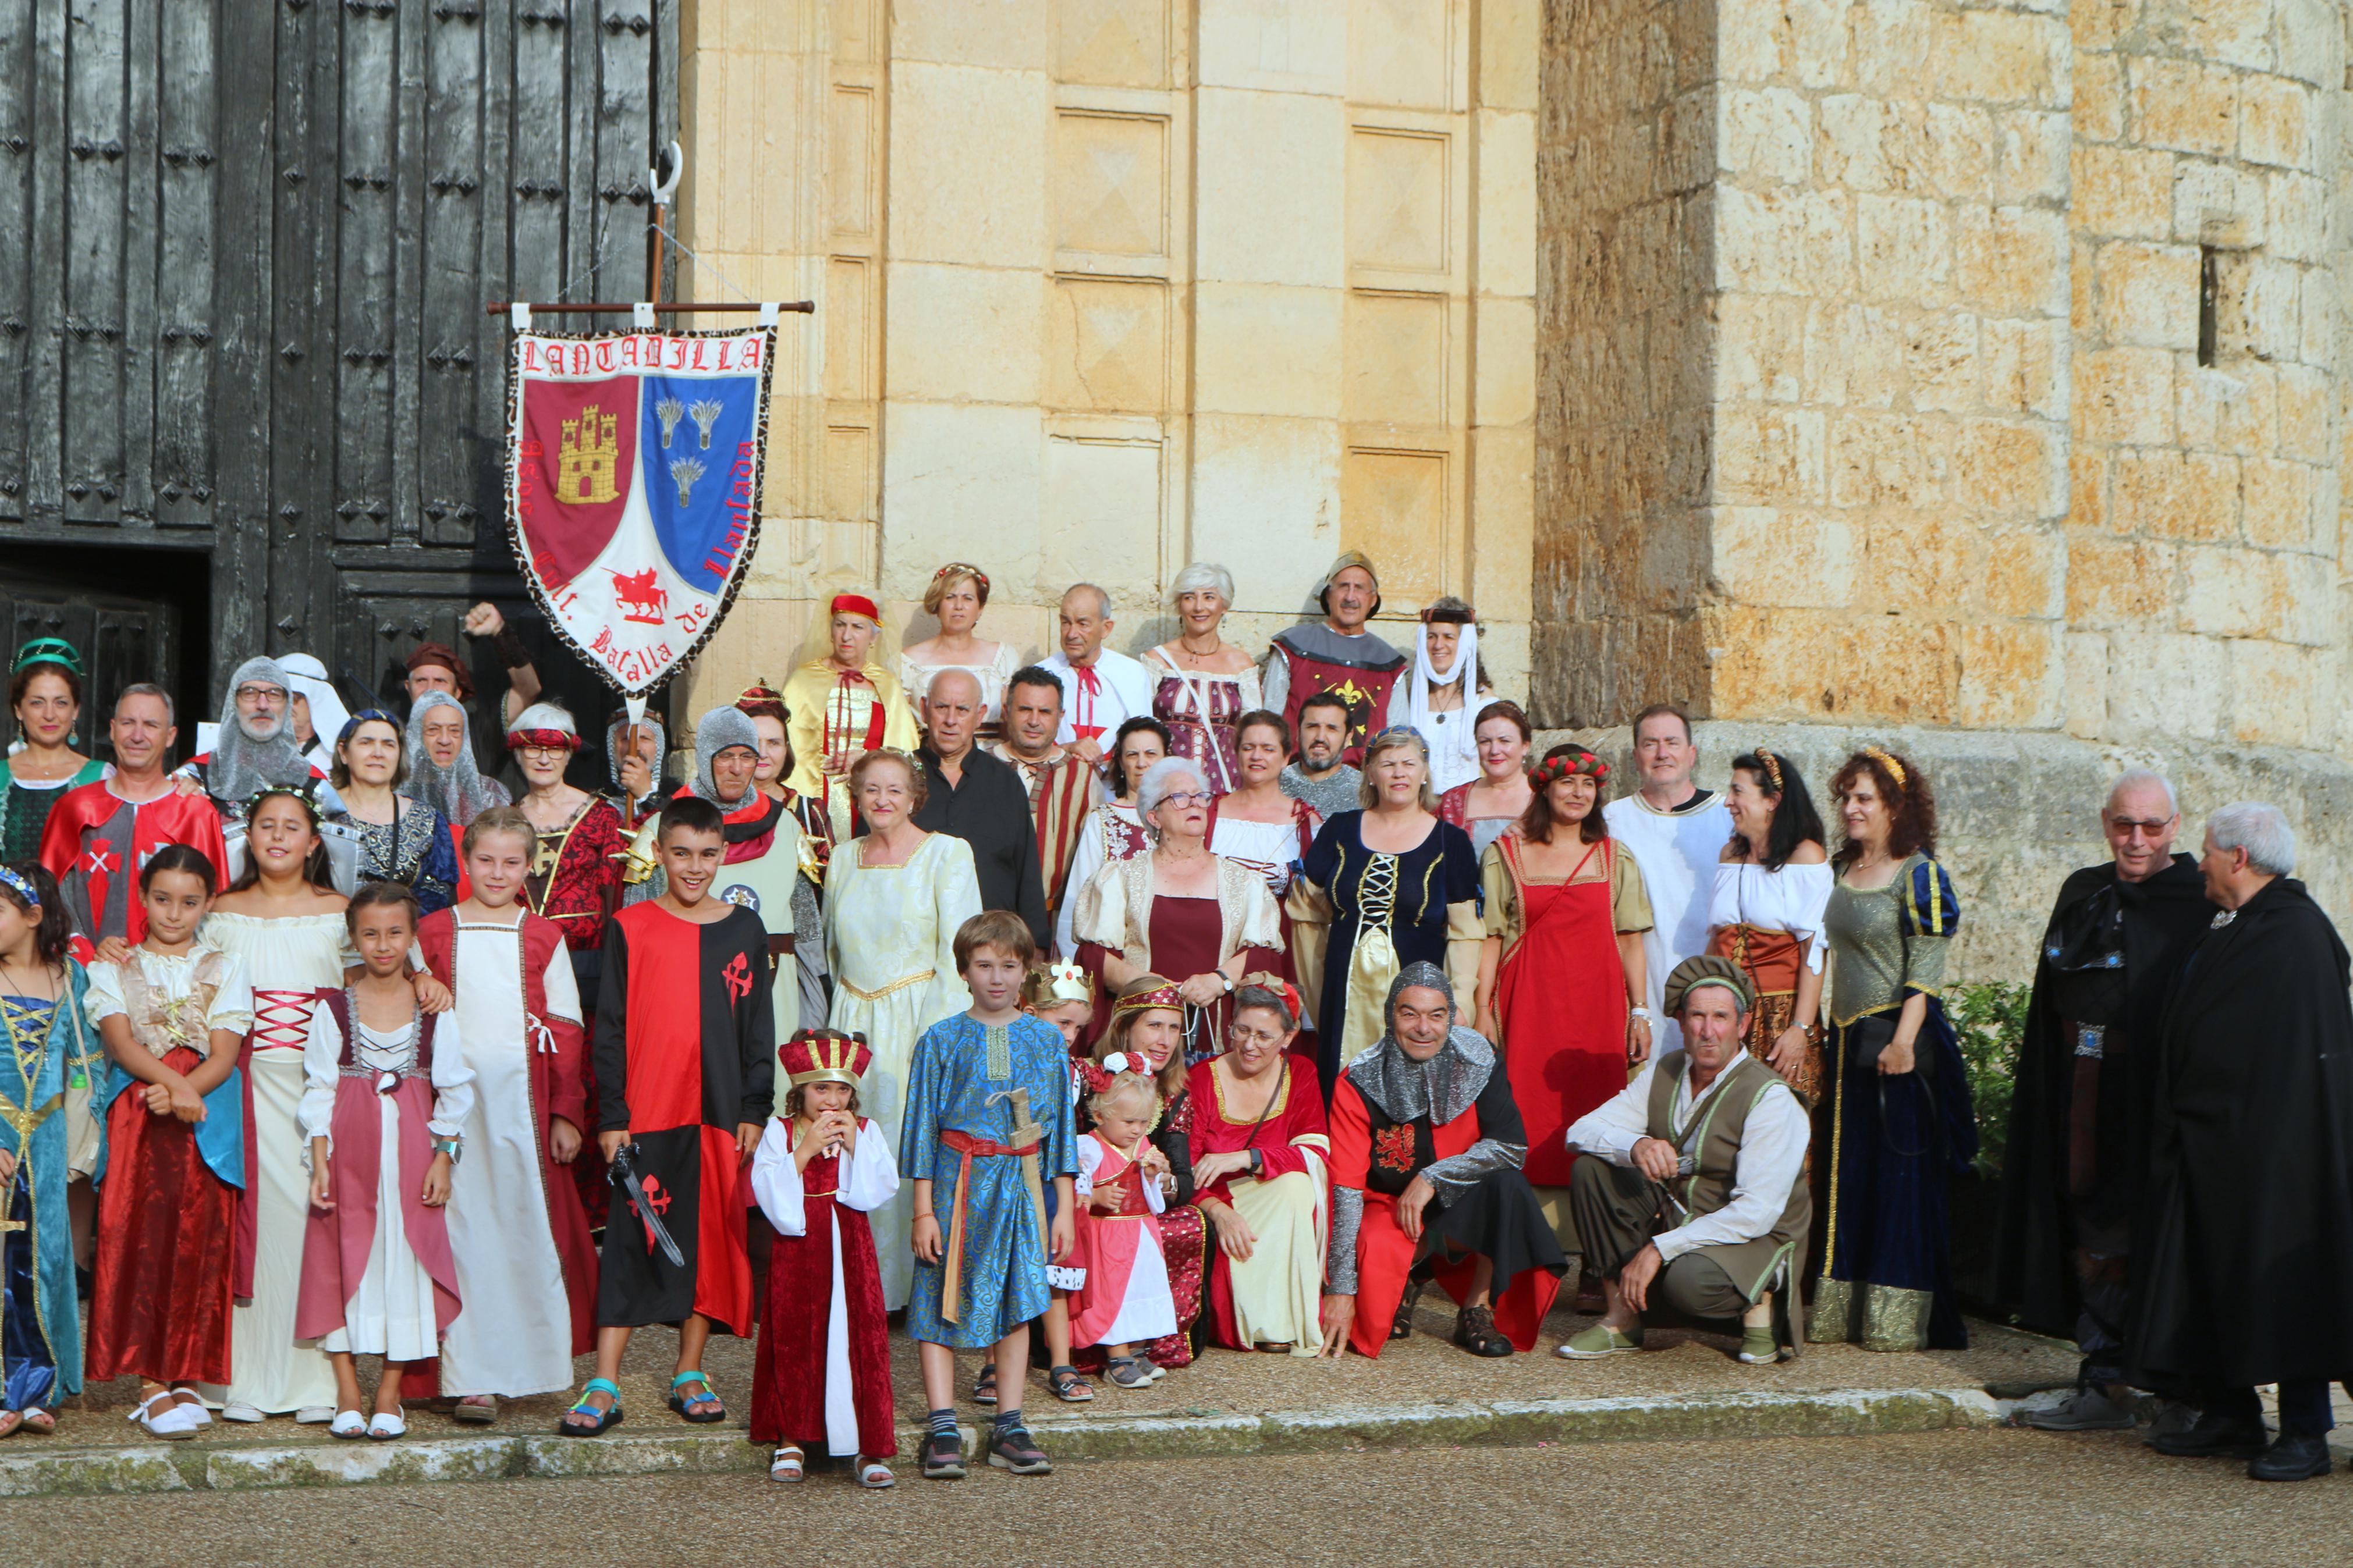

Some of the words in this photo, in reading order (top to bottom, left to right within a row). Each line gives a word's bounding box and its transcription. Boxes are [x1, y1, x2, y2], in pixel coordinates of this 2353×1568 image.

[523, 336, 762, 376] LANTADILLA
[533, 551, 577, 620] Cult.
[589, 624, 673, 681] Batalla
[675, 603, 708, 633] de
[703, 440, 755, 581] Llantada
